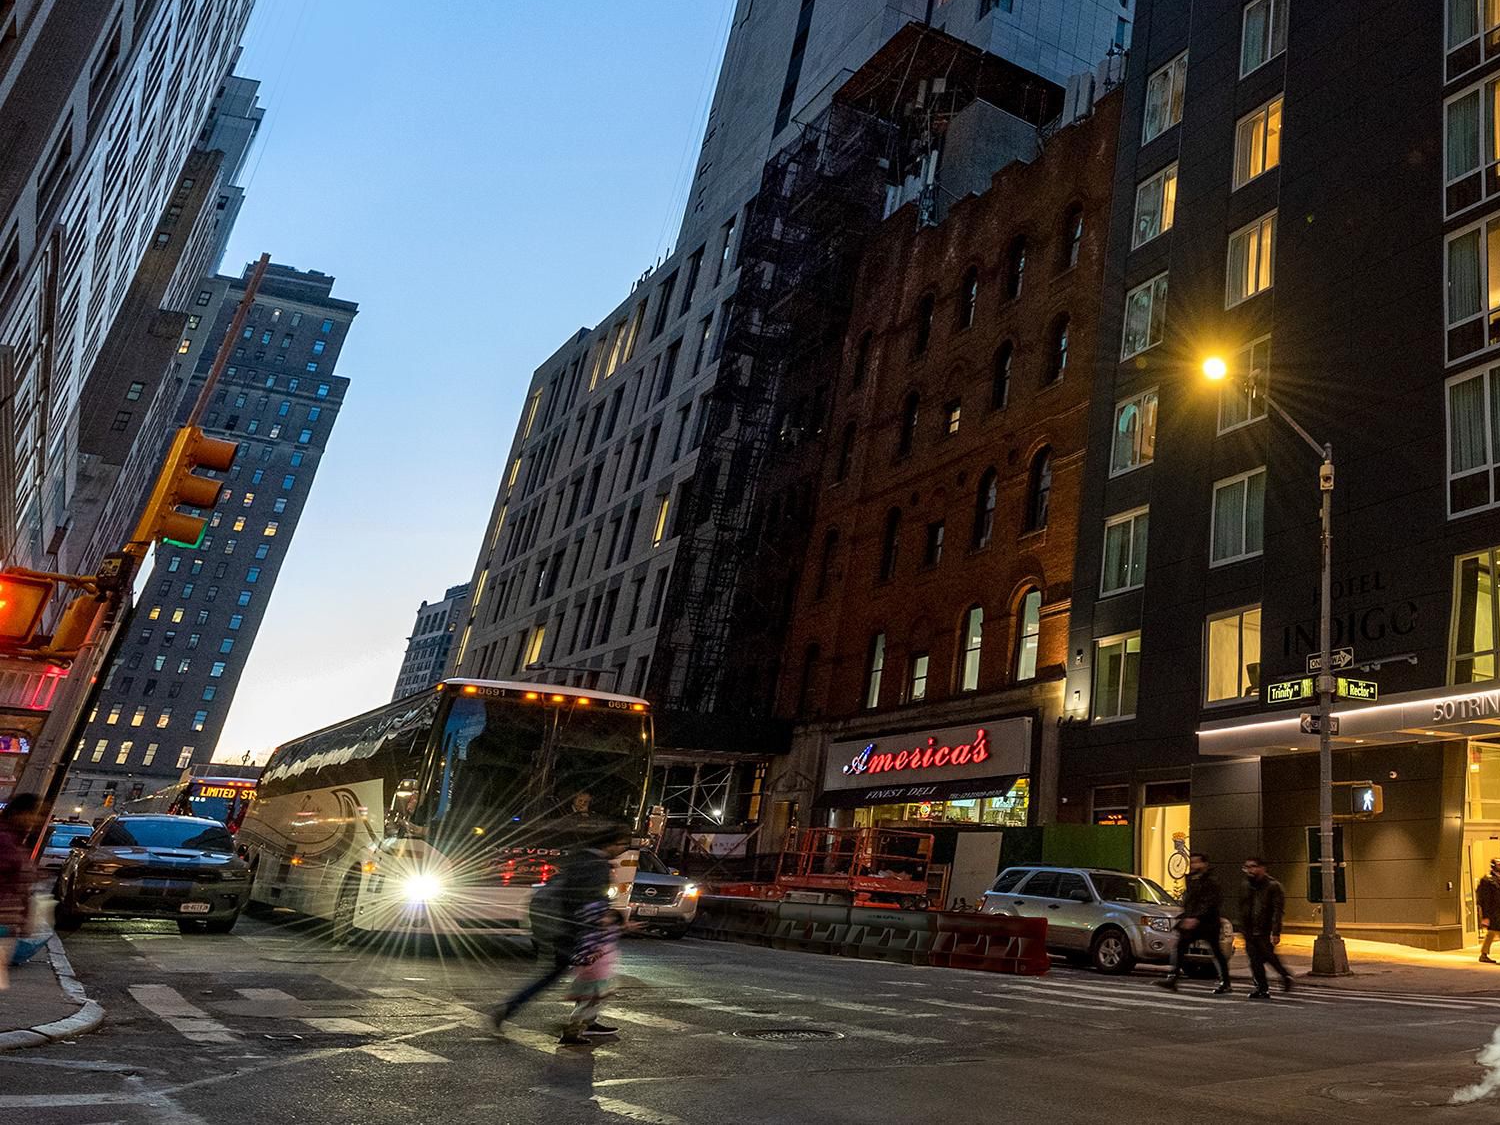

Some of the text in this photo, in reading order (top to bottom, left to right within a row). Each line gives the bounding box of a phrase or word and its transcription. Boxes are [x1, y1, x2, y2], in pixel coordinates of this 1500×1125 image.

[1284, 601, 1418, 656] INDIGO
[1332, 654, 1347, 665] WAY
[1271, 686, 1294, 699] Trinity
[1349, 683, 1370, 697] Rector
[1433, 702, 1455, 721] 50
[842, 728, 989, 775] America's
[200, 786, 236, 799] LIMITED
[865, 786, 938, 799] FINEST DELI
